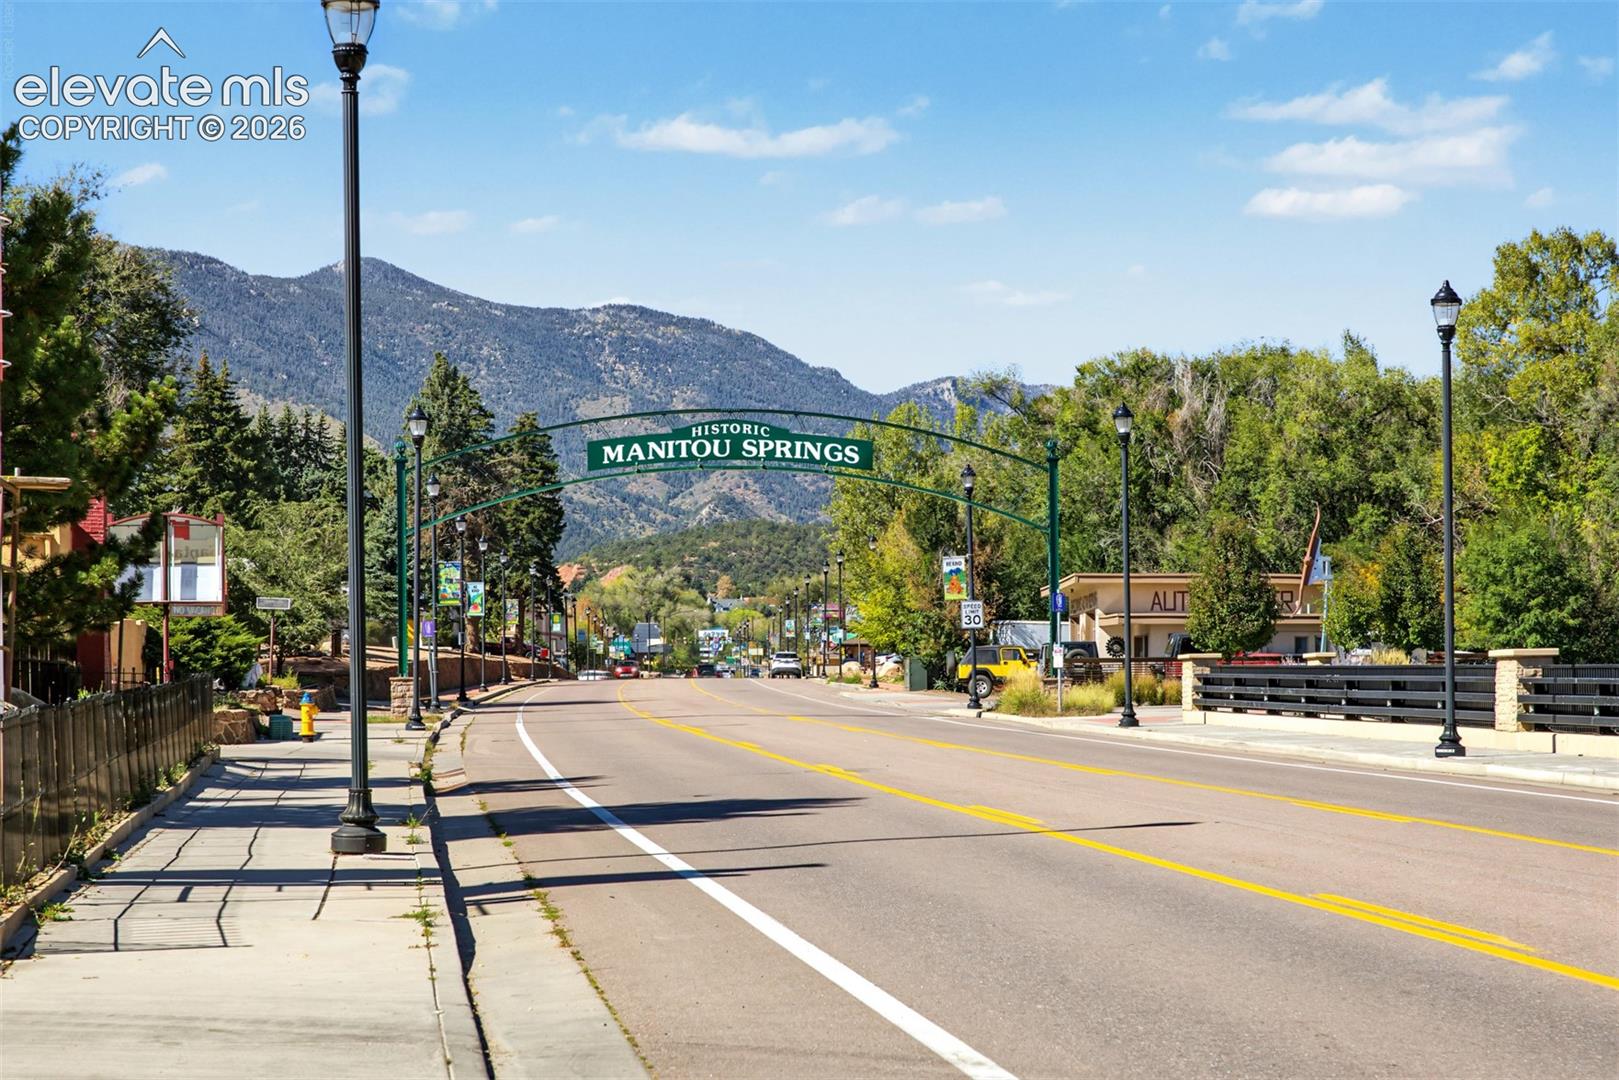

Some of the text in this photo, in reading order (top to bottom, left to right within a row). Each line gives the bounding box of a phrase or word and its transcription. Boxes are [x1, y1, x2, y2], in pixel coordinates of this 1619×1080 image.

[691, 424, 770, 437] HISTORIC
[602, 439, 860, 464] MANITOU SPRINGS
[1151, 591, 1188, 611] AUT
[964, 615, 981, 625] 30
